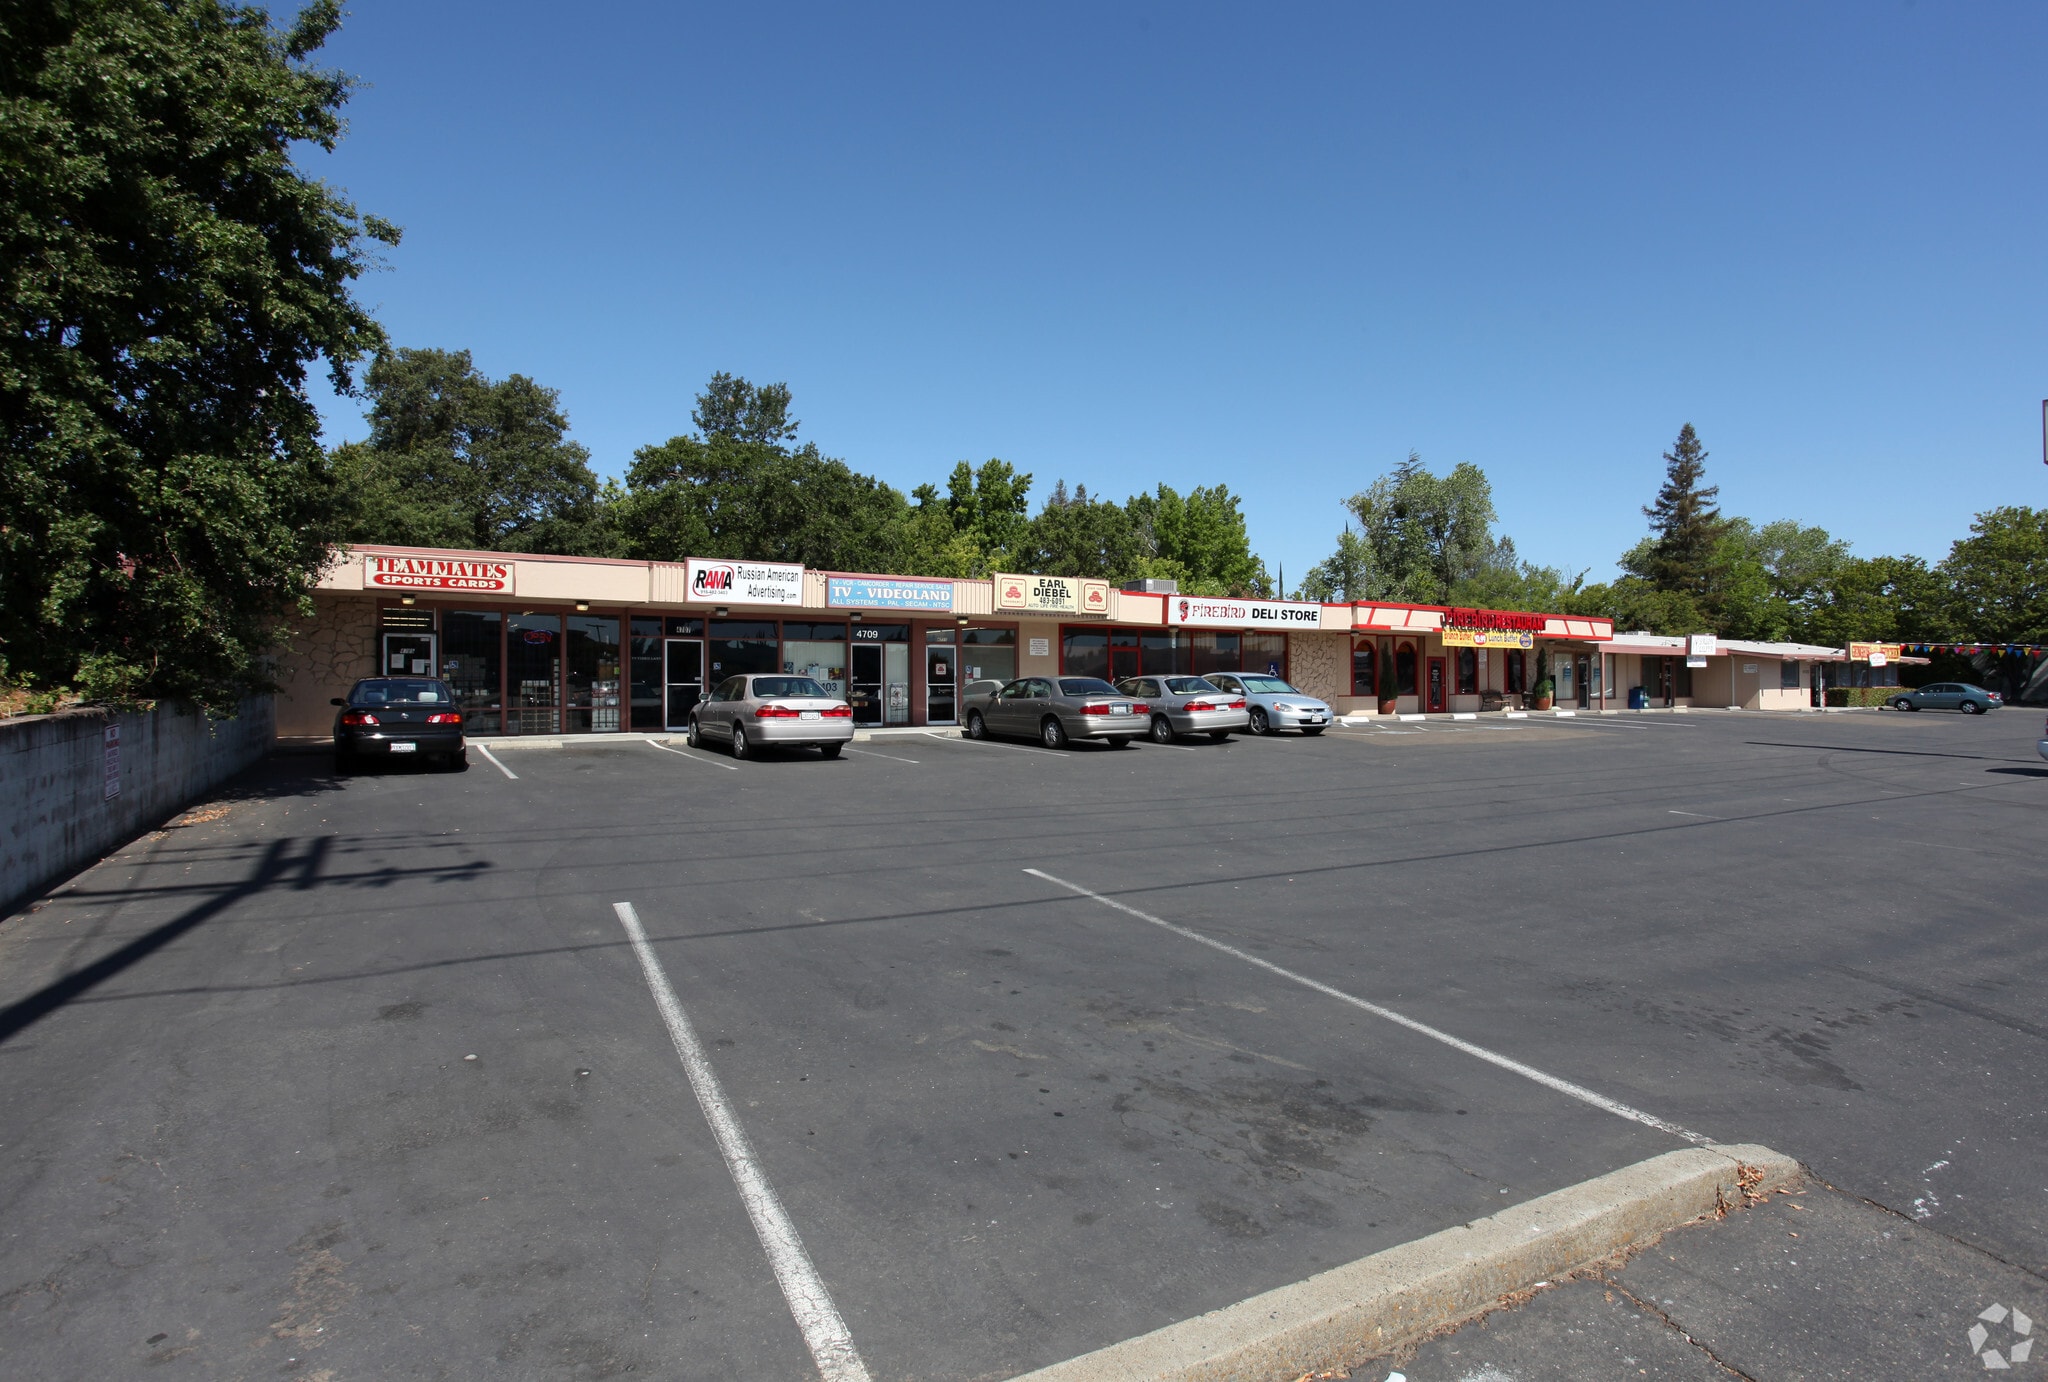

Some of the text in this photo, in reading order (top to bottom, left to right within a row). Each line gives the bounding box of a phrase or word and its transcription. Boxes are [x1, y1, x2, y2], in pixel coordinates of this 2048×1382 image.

[376, 558, 507, 579] TEAMMATES
[737, 566, 799, 583] Russian American
[382, 575, 497, 589] SPORTS CARDS
[695, 569, 732, 590] RAMA
[1039, 579, 1067, 589] EARL
[832, 586, 852, 598] TV
[867, 587, 950, 601] VIDEOLAND
[1033, 587, 1071, 598] DIEBEL
[1251, 608, 1278, 620] DELI
[1281, 609, 1318, 622] STORE
[1445, 612, 1495, 629] FIREBIRD
[524, 631, 552, 643] OPEN
[856, 630, 878, 639] 4709
